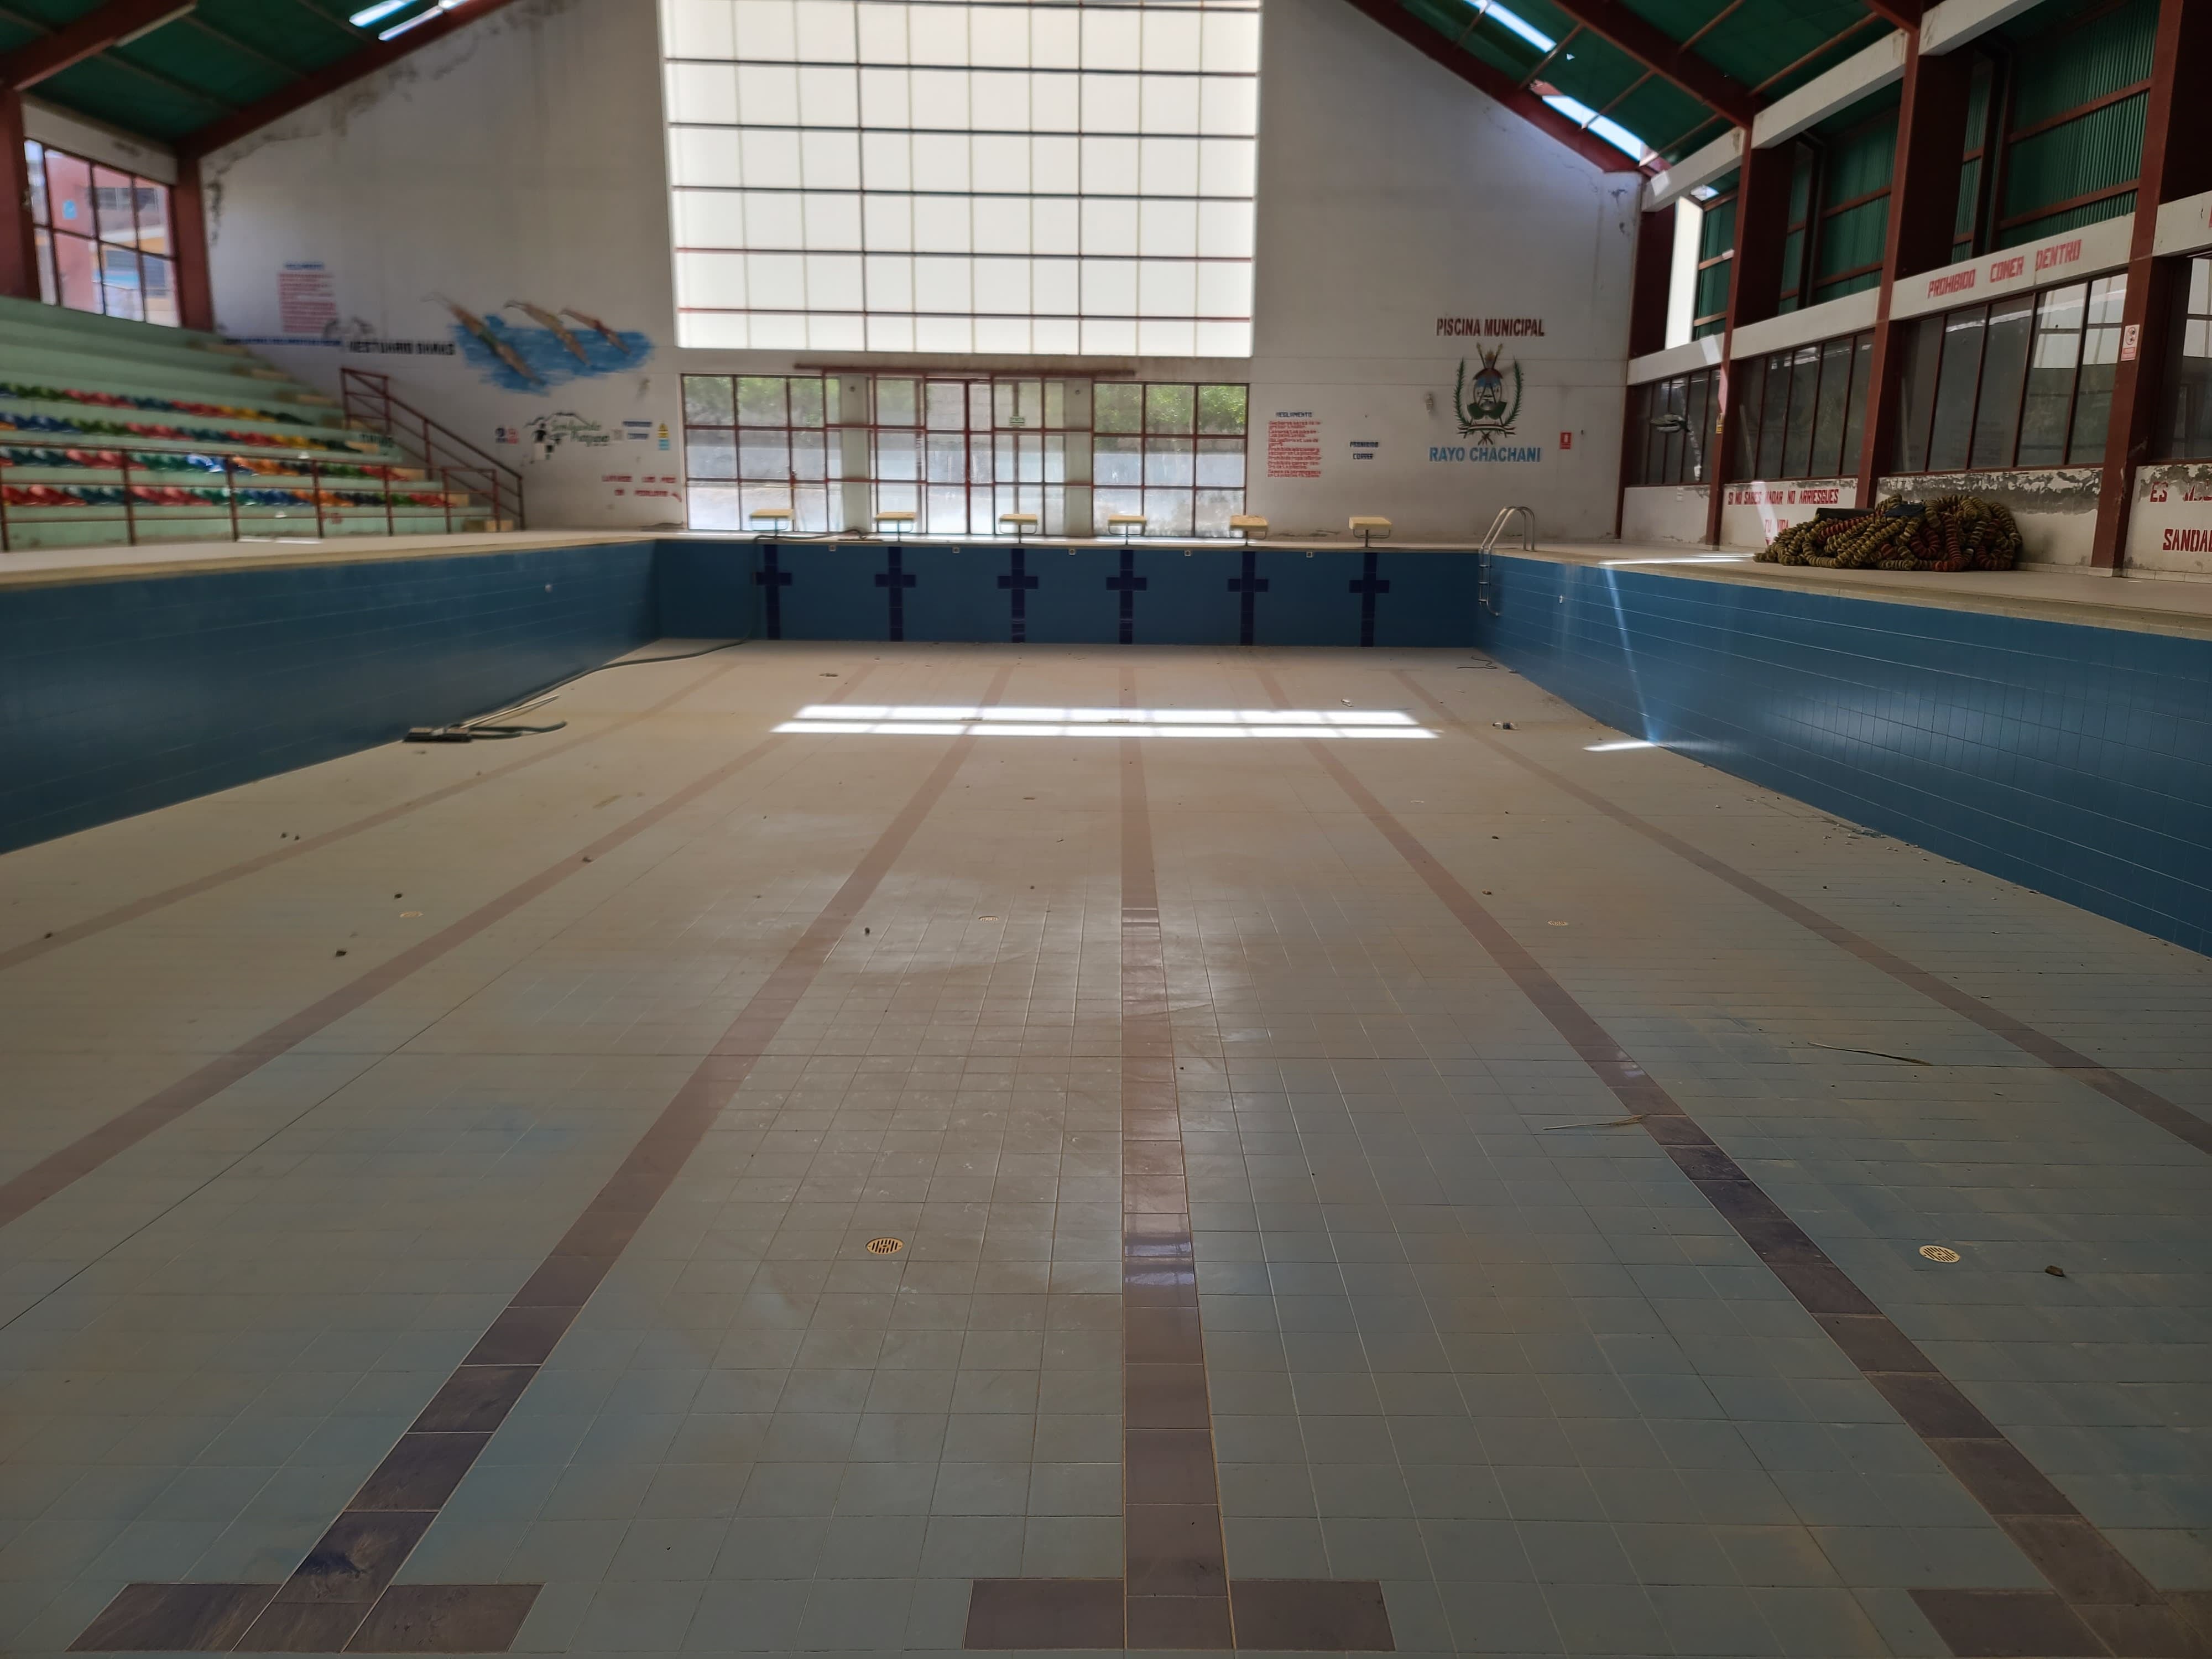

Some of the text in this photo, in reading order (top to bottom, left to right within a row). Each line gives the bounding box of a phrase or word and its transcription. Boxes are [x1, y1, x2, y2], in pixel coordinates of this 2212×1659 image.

[1928, 239, 2081, 299] PROHIBIDO COMER DENTRO
[1436, 319, 1545, 337] PISCINA MUNICIPAL
[1429, 447, 1541, 462] RAYO CHACHANI
[1787, 490, 1796, 504] NO
[1799, 489, 1839, 504] ARRIESGUES
